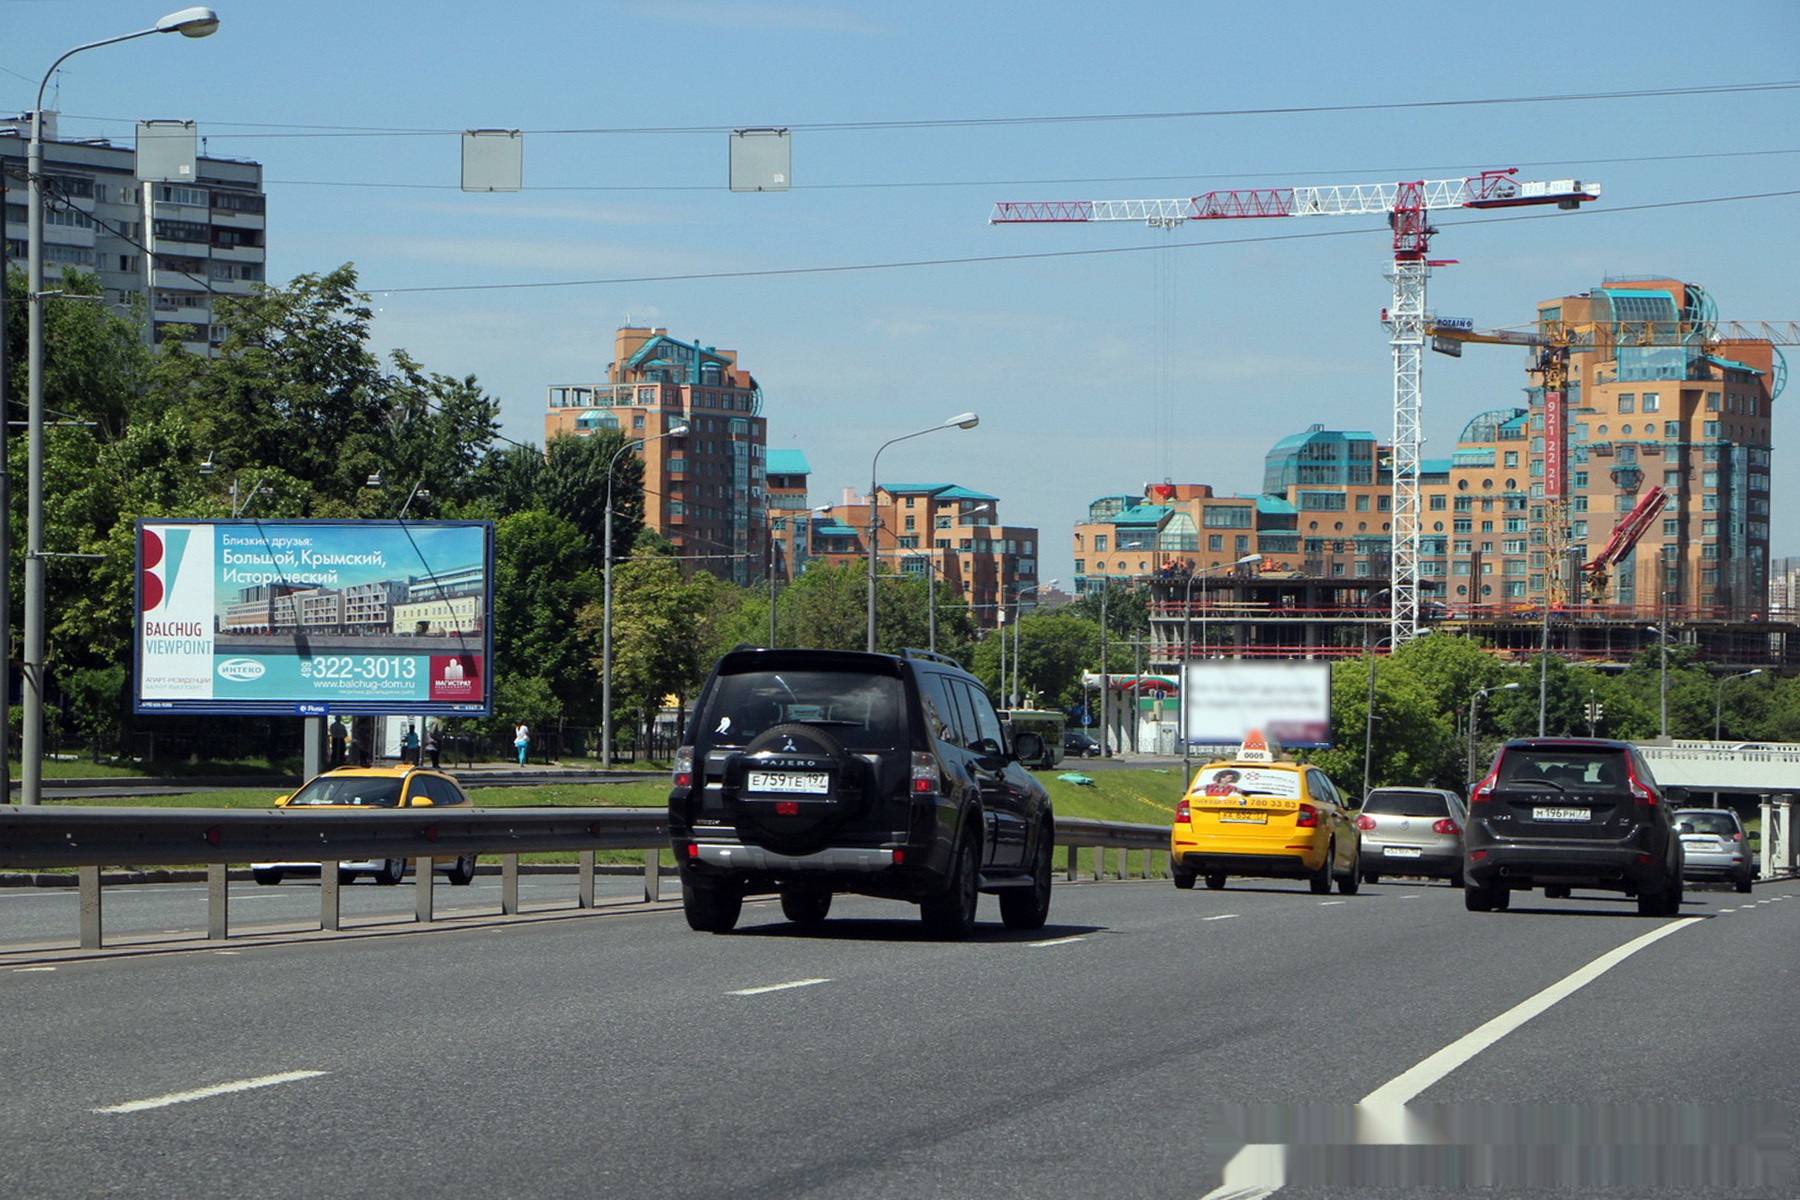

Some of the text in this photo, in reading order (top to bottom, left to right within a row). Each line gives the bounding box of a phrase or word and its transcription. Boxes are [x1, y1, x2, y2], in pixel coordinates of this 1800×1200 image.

[223, 534, 313, 549] Близкие друзья:
[223, 549, 387, 569] Большой, Крымский,
[223, 568, 338, 587] Исторический
[146, 621, 202, 637] BALCHUG
[146, 639, 213, 655] VIEWPOINT
[222, 666, 262, 674] ИНТЕКО
[313, 657, 416, 679] 322-3013
[314, 680, 416, 691] www.balchug-dom.ru
